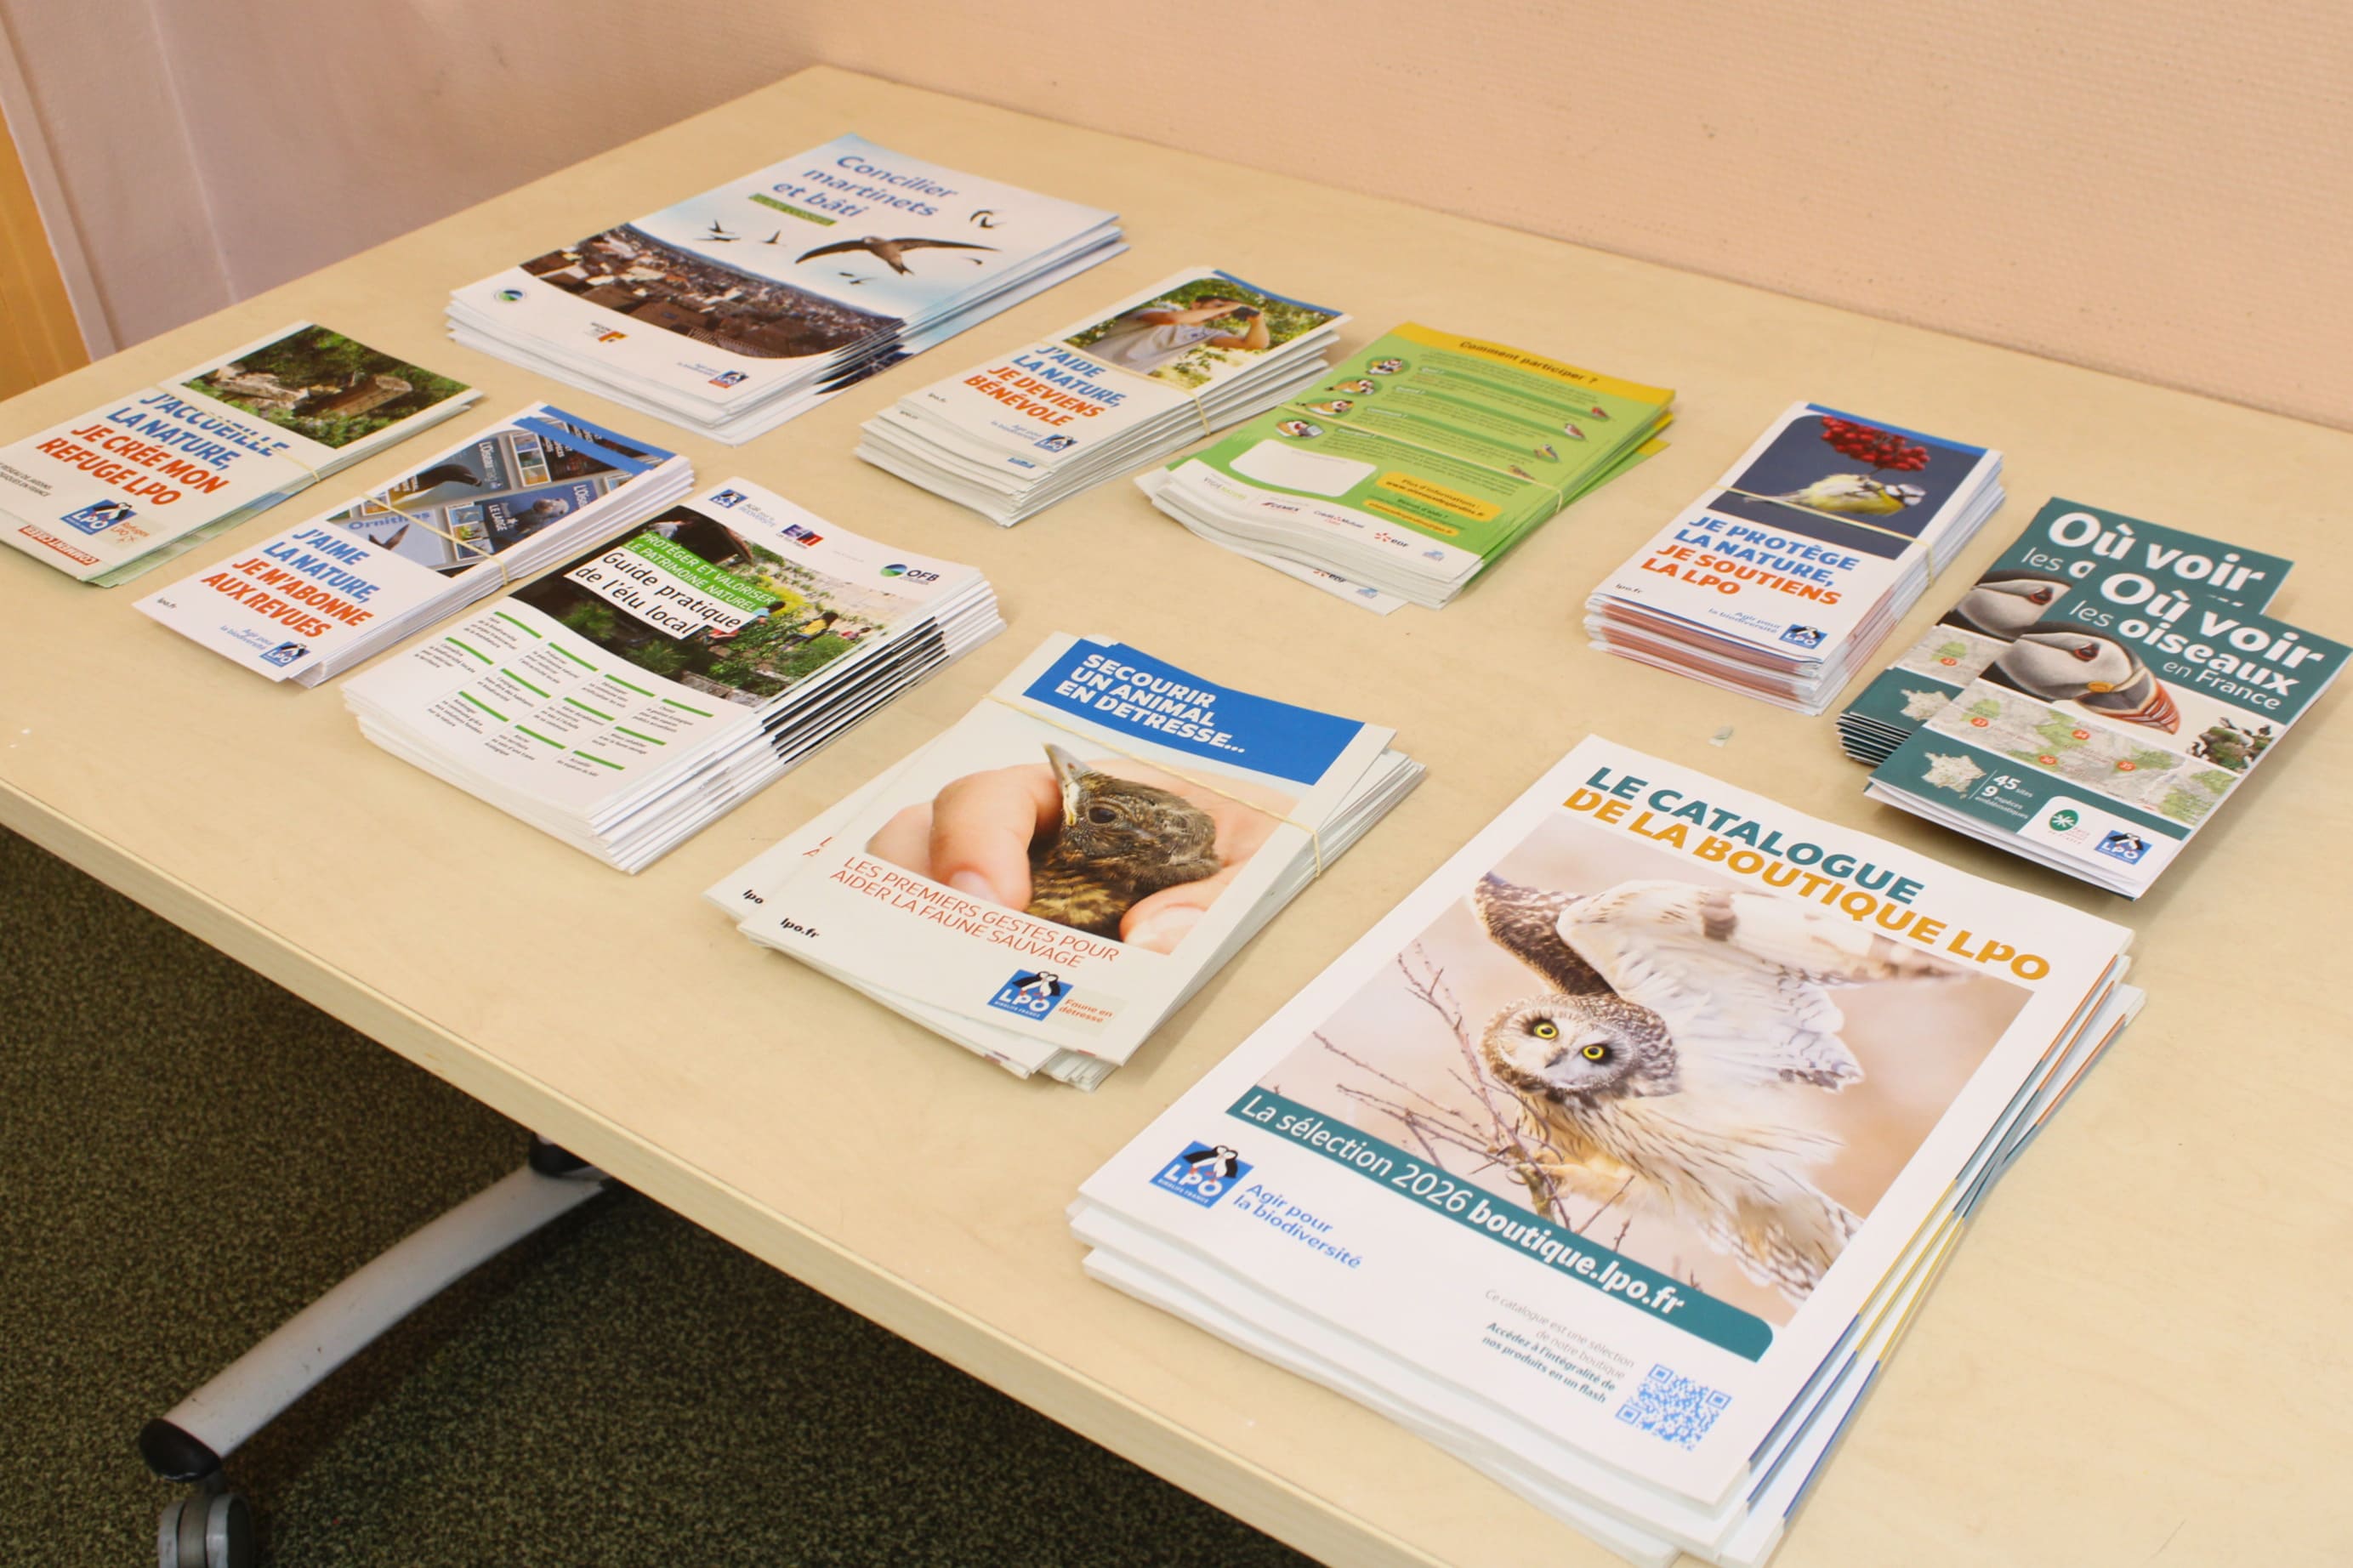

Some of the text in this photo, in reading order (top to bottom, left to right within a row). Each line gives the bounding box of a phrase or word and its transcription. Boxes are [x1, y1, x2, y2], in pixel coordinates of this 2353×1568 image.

[773, 182, 806, 197] et
[804, 190, 869, 217] bâti
[803, 169, 939, 216] martinets
[837, 156, 958, 197] Concilier
[1012, 355, 1127, 407] LA NATURE,
[1036, 346, 1105, 378] J'AIDE
[1460, 341, 1520, 361] Comment
[1520, 357, 1585, 381] participer
[963, 374, 1074, 426] BÉNÉVOLE
[987, 366, 1105, 418] JE DEVIENS
[71, 424, 230, 494] JE CRÉE MON
[106, 407, 241, 471] LA NATURE,
[36, 437, 135, 486] REFUGE
[126, 476, 182, 506] LPO
[71, 511, 108, 529] LPO
[293, 529, 370, 565] J'AIME
[1689, 517, 1860, 571] JE PROTÈGE
[263, 542, 381, 604] LA NATURE,
[625, 542, 759, 612] LE PATRIMOINE NATUREL
[643, 533, 776, 605] PROTÉGER ET VALORISER
[907, 569, 940, 582] OFB
[1640, 558, 1741, 595] LA LPO
[1657, 545, 1842, 605] JE SOUTIENS
[1674, 530, 1834, 588] LA NATURE,
[2021, 547, 2064, 571] les
[2048, 512, 2266, 592] Où voir
[201, 572, 332, 638] AUX REVUES
[232, 559, 374, 627] JE M'ABONNE
[575, 567, 698, 634] de l'élu local
[603, 552, 741, 628] Guide pratique
[1785, 632, 1816, 646] LPO
[2068, 600, 2299, 696] les oiseaux
[2100, 573, 2325, 669] Où voir
[1070, 667, 1217, 727] UN ANIMAL
[1083, 654, 1217, 708] SECOURIR
[2163, 660, 2282, 711] en France
[1054, 681, 1246, 753] EN DETRESSE...
[1981, 786, 1998, 797] 9
[1993, 775, 2021, 790] 45
[1584, 767, 1924, 904] LE CATALOGUE
[2102, 842, 2139, 859] LPO
[742, 889, 764, 906] lpo
[844, 856, 1120, 963] LES PREMIERS GESTES POUR
[1562, 787, 2050, 981] DE LA BOUTIQUE LPO
[780, 918, 820, 939] lpo.fr
[830, 869, 1087, 969] AIDER LA FAUNE SAUVAGE
[998, 989, 1050, 1012] LPO
[1059, 1006, 1104, 1023] détresse
[1065, 998, 1097, 1013] Faune
[1163, 1164, 1222, 1197] LPO
[1241, 1094, 1685, 1316] La sélection 2026 boutique.lpo.fr
[1233, 1194, 1363, 1269] la biodiversité
[1246, 1184, 1333, 1233] Agir pour
[1485, 1289, 1634, 1369] Ce catalogue est une sélection
[1536, 1330, 1626, 1379] de notre boutique
[1482, 1337, 1606, 1404] nos produits en un flash
[1486, 1322, 1616, 1391] Accédez à l'intégralité de
